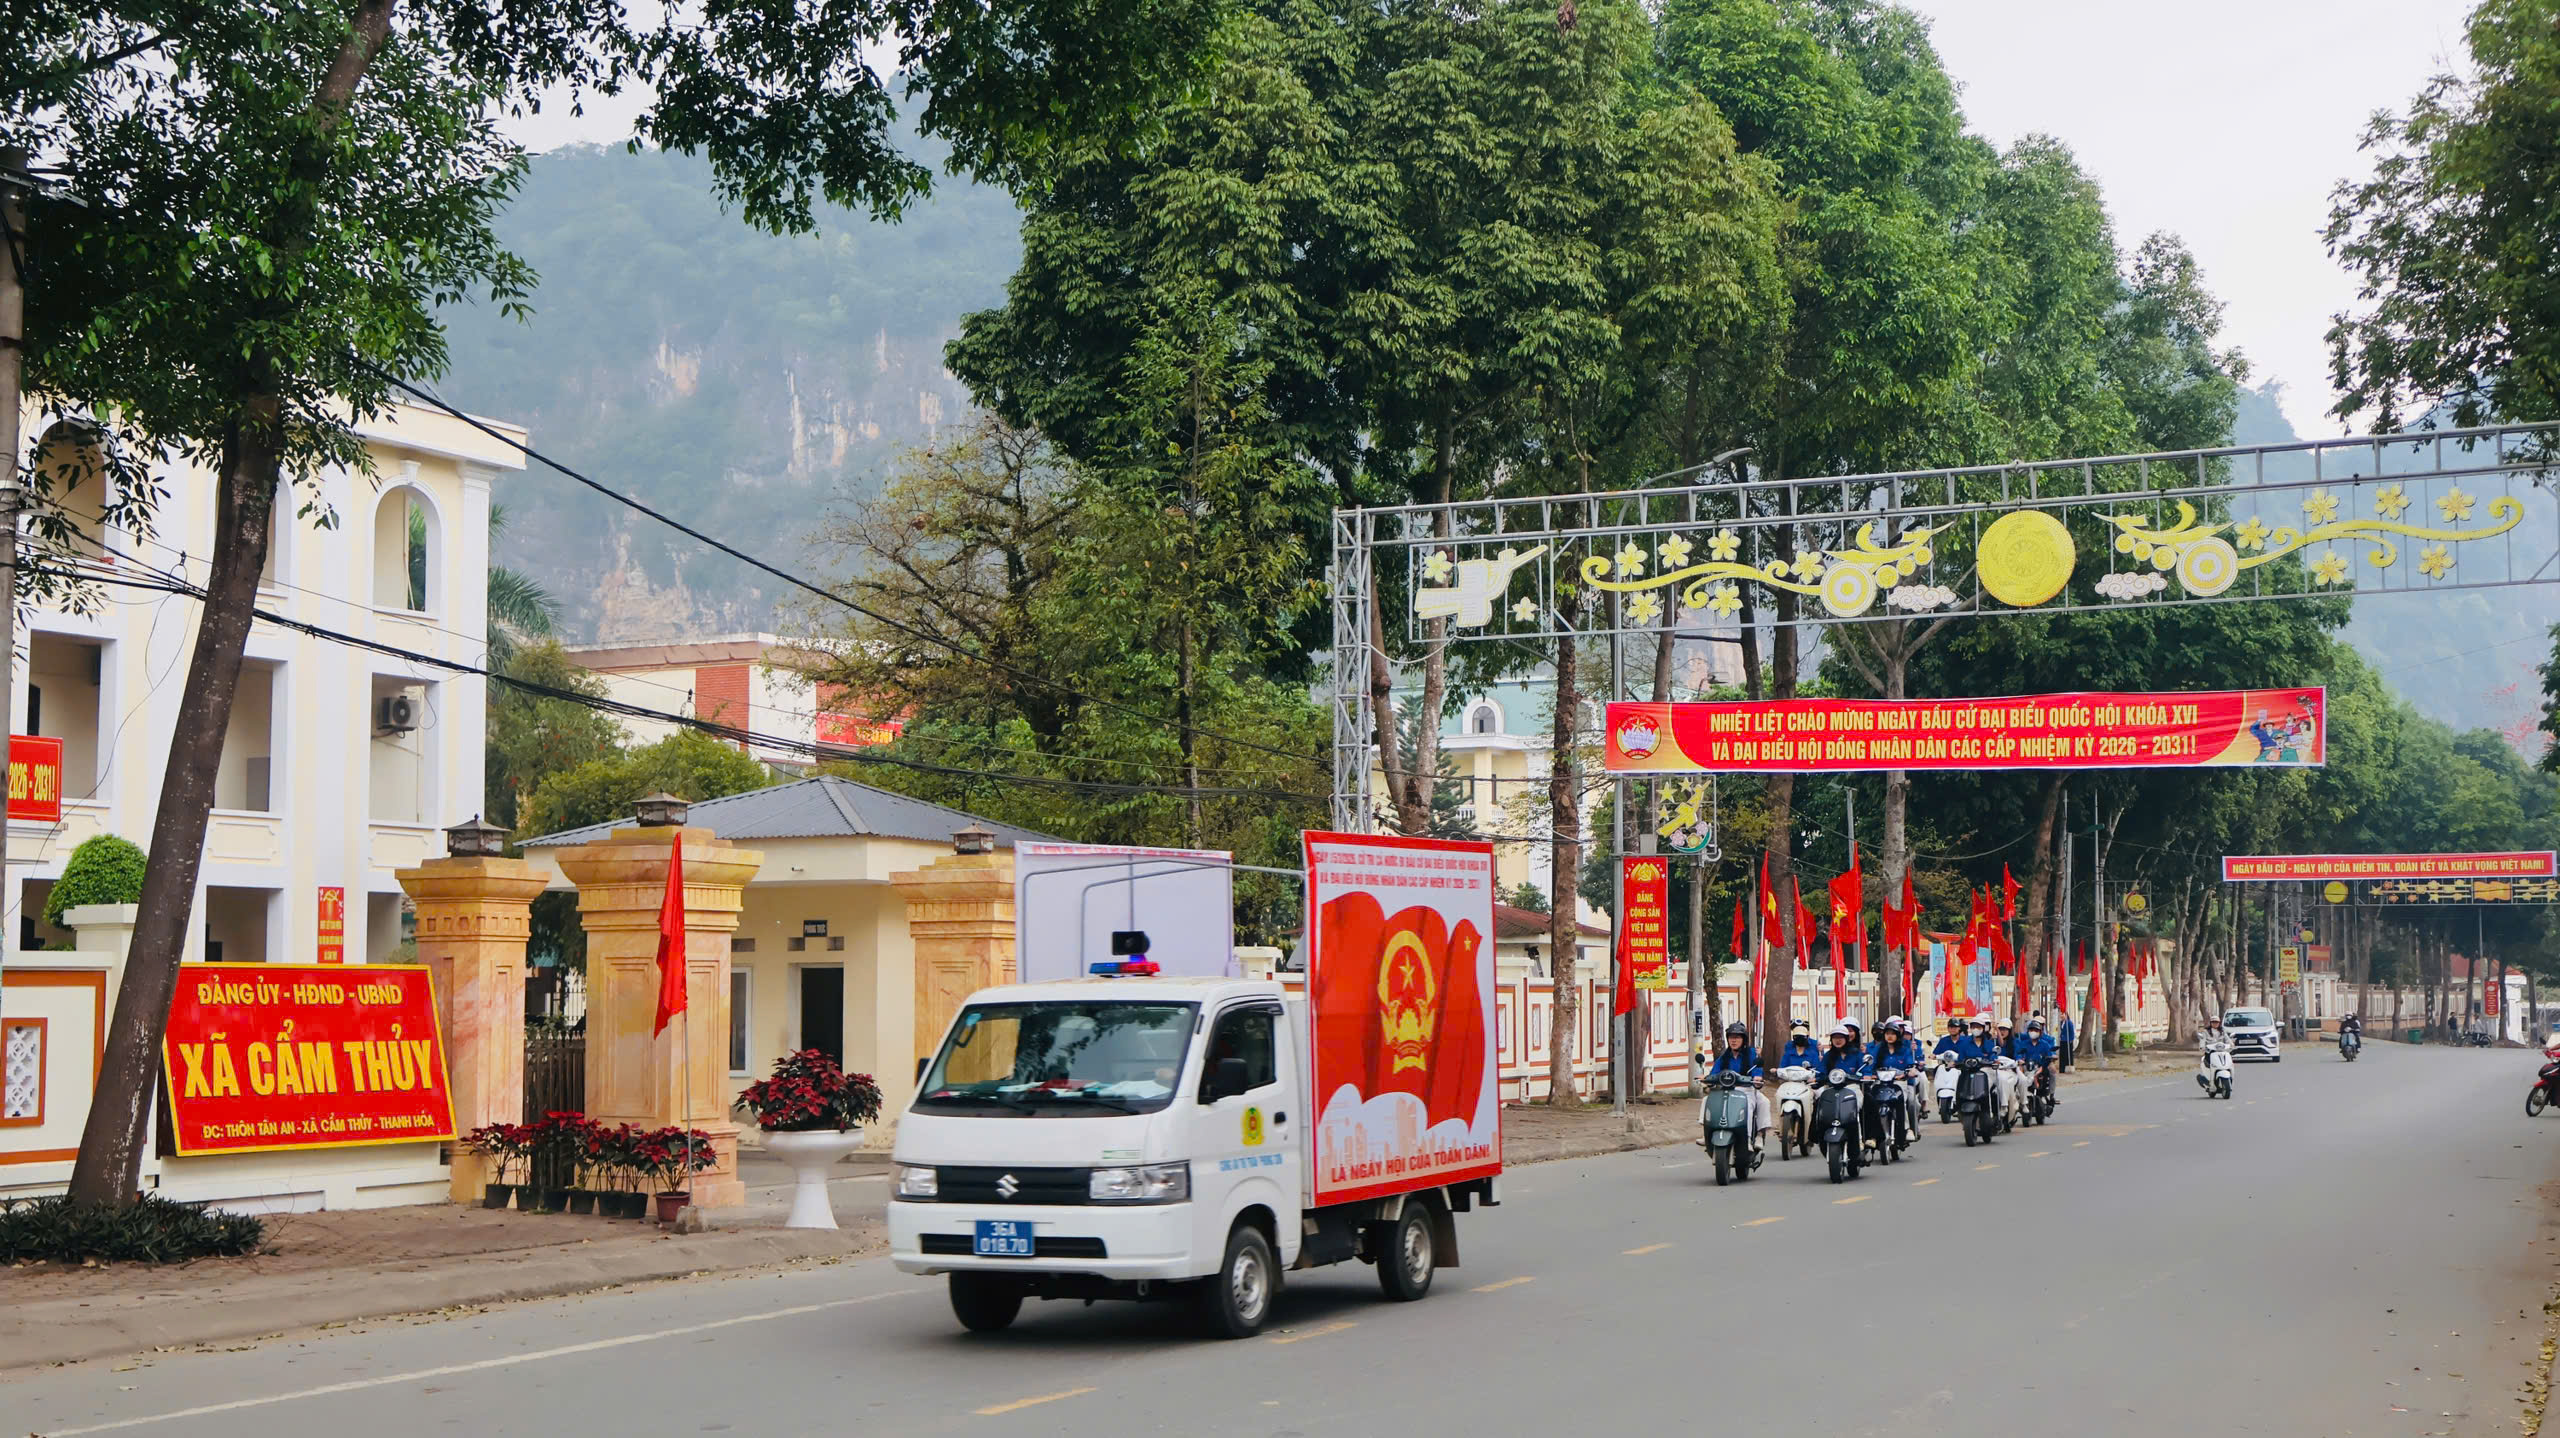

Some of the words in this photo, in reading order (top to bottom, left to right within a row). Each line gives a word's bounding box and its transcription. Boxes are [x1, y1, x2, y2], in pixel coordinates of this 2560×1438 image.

[1710, 709, 1752, 736] NHIỆT
[1755, 709, 1784, 735] LIỆT
[1787, 708, 1826, 731] CHÀO
[1830, 707, 1874, 731] MỪNG
[1877, 706, 1917, 730] NGÀY
[1922, 703, 1951, 729] BẦU
[1956, 703, 1978, 729] CỬ
[1980, 708, 2005, 733] ĐẠI
[2010, 701, 2044, 728] BIỂU
[2049, 701, 2090, 729] QUỐC
[2095, 703, 2121, 731] HỘI
[2125, 701, 2167, 726] KHÓA
[2172, 705, 2198, 725] XVI
[1712, 738, 1730, 761] VÀ
[1734, 741, 1757, 765] ĐẠI
[1762, 734, 1794, 761] BIỂU
[1797, 737, 1822, 765] HỘI
[1826, 734, 1866, 760] ĐỒNG
[1870, 736, 1911, 760] NHÂN
[1915, 735, 1947, 759] DÂN
[1951, 735, 1981, 759] CÁC
[1985, 732, 2016, 758] CẤP
[2020, 734, 2070, 761] NHIỆM
[2074, 733, 2095, 757] KỲ
[2099, 736, 2137, 757] 2026
[2152, 735, 2196, 755] 2031!
[8, 762, 28, 800] 2026
[34, 764, 55, 801] 2031!
[2232, 862, 2254, 874] NGÀY
[2294, 862, 2315, 873] NGÀY
[2317, 862, 2332, 876] HỘI
[2333, 860, 2350, 873] CỦA
[2420, 858, 2435, 872] KẾT
[2438, 859, 2449, 871] VÀ
[2451, 859, 2473, 871] KHÁT
[2475, 861, 2498, 873] VỌNG
[2500, 859, 2518, 872] VIỆT
[2521, 860, 2544, 870] NAM!
[1637, 890, 1653, 903] ĐẢNG
[1630, 907, 1647, 920] CỘNG
[1648, 906, 1661, 917] SẢN
[1631, 922, 1644, 935] VIỆT
[1645, 923, 1659, 932] NAM
[198, 974, 255, 1005] ĐẢNG
[257, 975, 280, 1005] ỦY
[293, 984, 344, 1005] HĐND
[357, 983, 403, 1005] UBND
[178, 1031, 241, 1098] XÃ
[247, 1018, 338, 1096] CẨM
[343, 1023, 432, 1093] THỦY
[202, 1124, 224, 1139] ĐC:
[225, 1120, 256, 1137] THÔN
[257, 1119, 278, 1135] TÂN
[280, 1121, 295, 1135] AN
[302, 1117, 318, 1134] XÃ
[321, 1112, 346, 1133] CẨM
[347, 1113, 372, 1131] THỦY
[379, 1116, 412, 1130] THANH
[414, 1110, 435, 1128] HÓA
[1331, 1163, 1347, 1183] LÀ
[1350, 1158, 1382, 1180] NGÀY
[1386, 1156, 1405, 1176] HỘI
[1409, 1149, 1431, 1171] CỦA
[1434, 1145, 1462, 1165] TOÀN
[1465, 1143, 1490, 1161] DÂN!
[990, 1222, 1017, 1236] 36A
[980, 1237, 1028, 1252] 018.70
